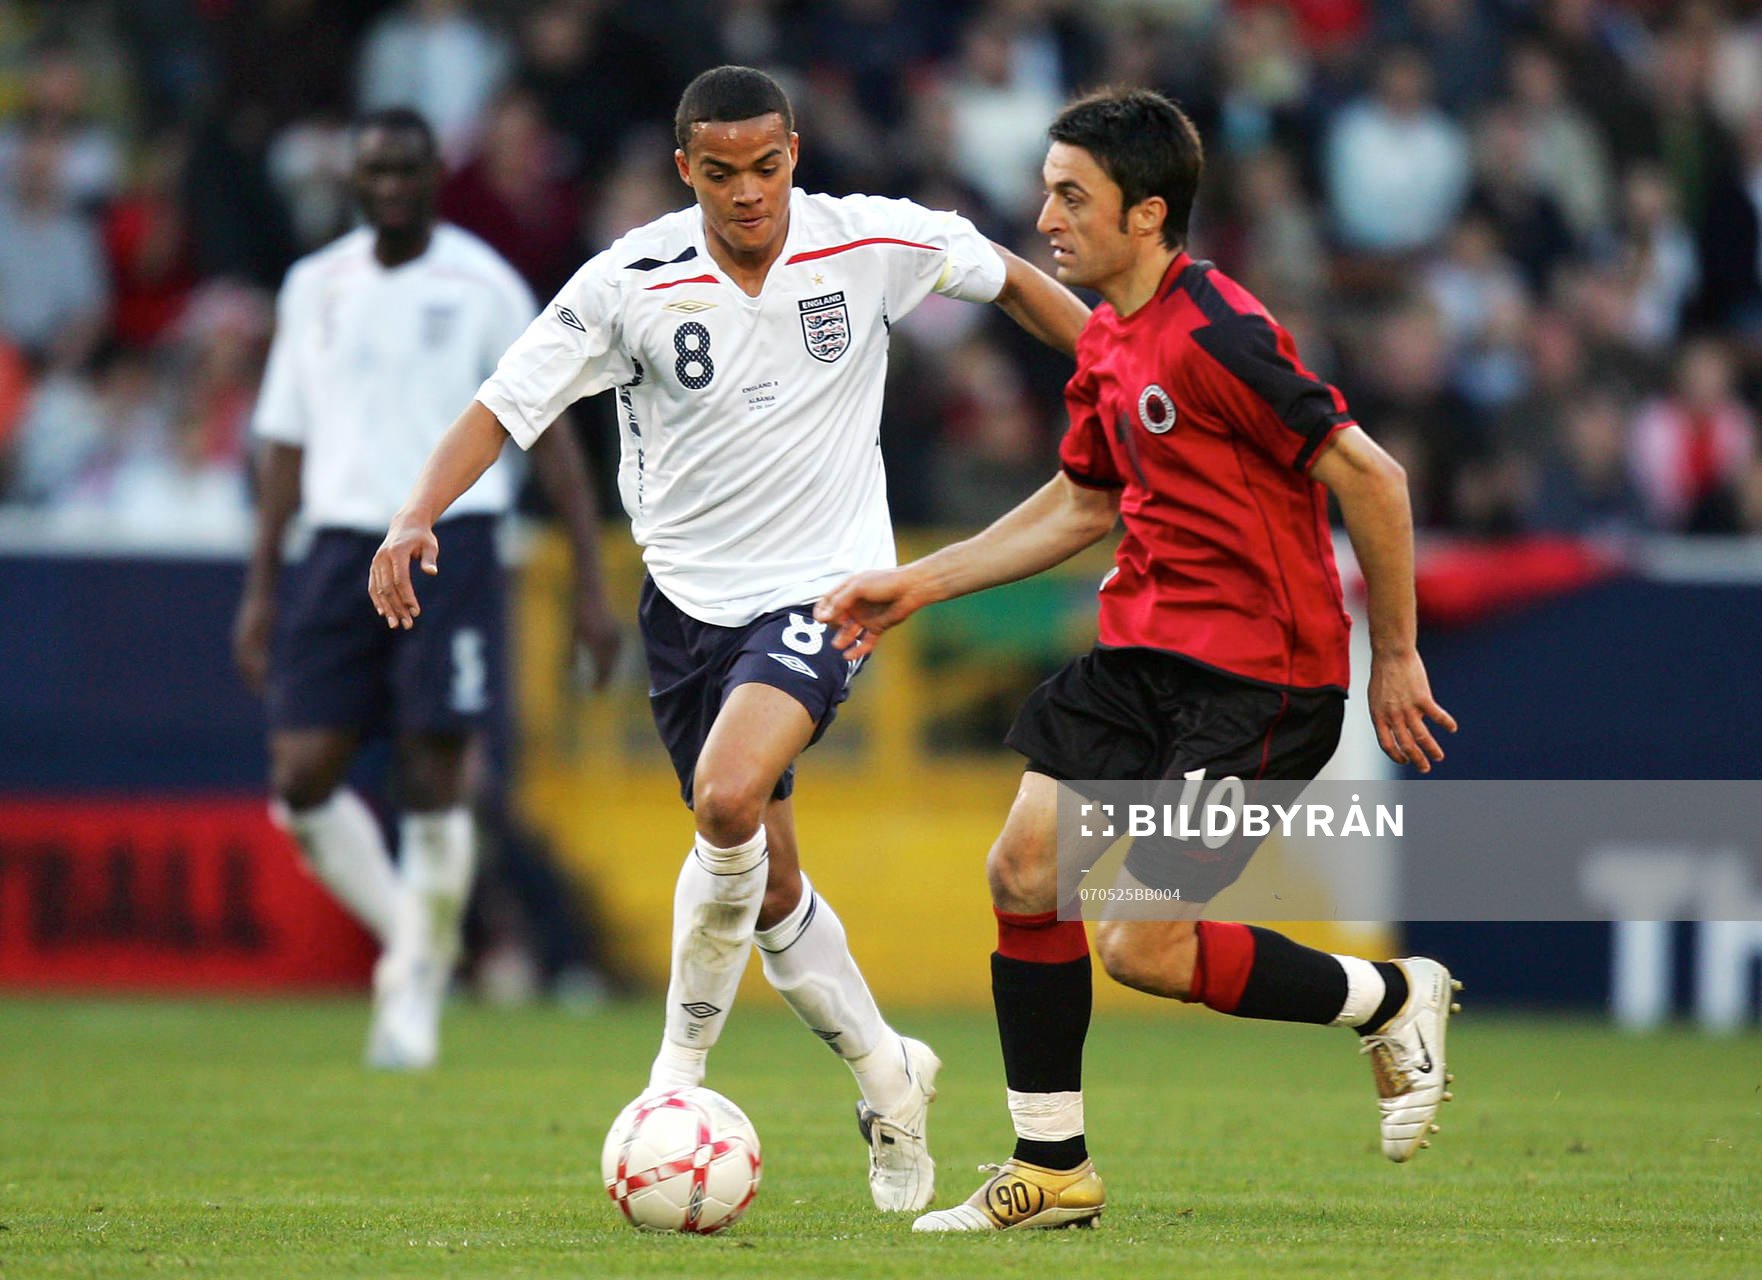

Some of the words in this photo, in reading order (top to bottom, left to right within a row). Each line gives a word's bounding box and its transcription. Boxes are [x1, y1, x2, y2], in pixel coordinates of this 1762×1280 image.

[802, 294, 842, 309] ENGLAND
[674, 321, 714, 390] 8
[782, 612, 828, 655] 8
[1170, 768, 1246, 849] 10
[996, 1181, 1031, 1216] 90
